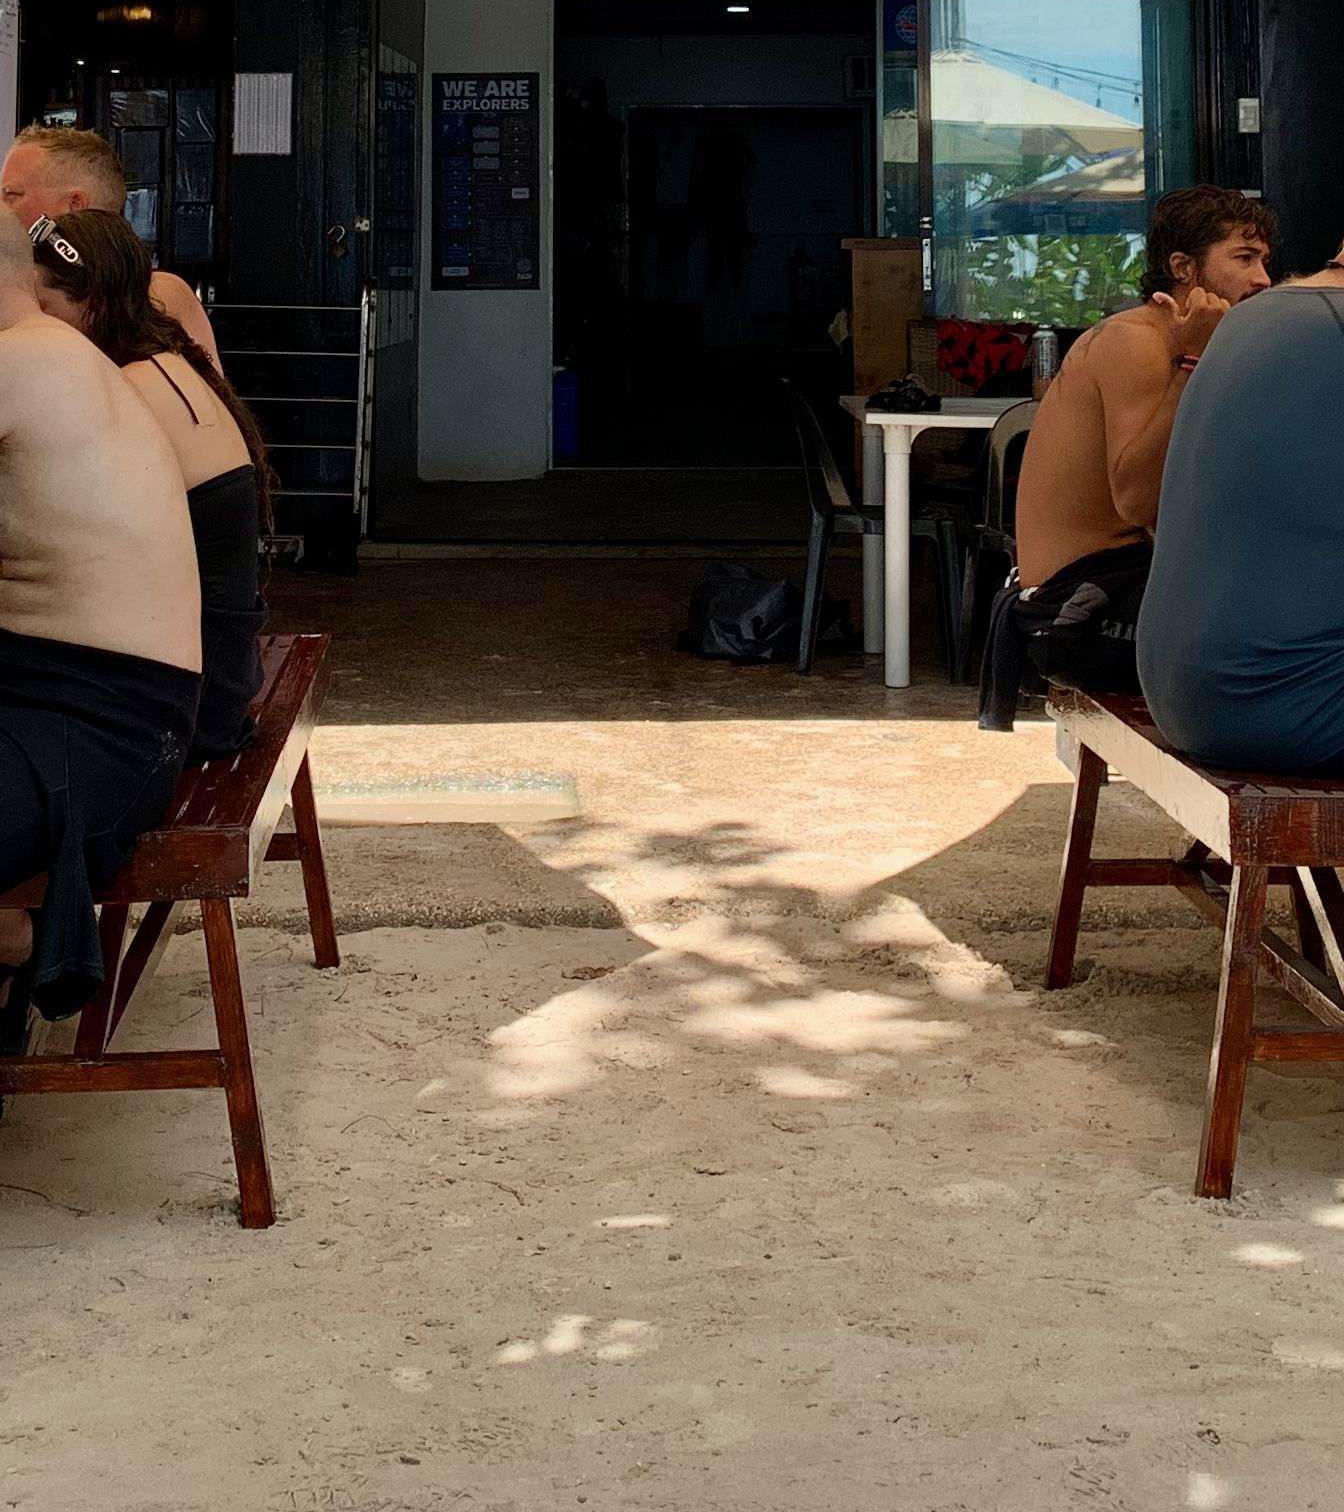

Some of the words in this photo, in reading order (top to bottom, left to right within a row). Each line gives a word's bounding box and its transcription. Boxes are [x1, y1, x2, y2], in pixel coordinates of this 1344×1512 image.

[442, 80, 477, 97] WE
[484, 80, 530, 97] ARE
[442, 99, 530, 110] EXPLORERS
